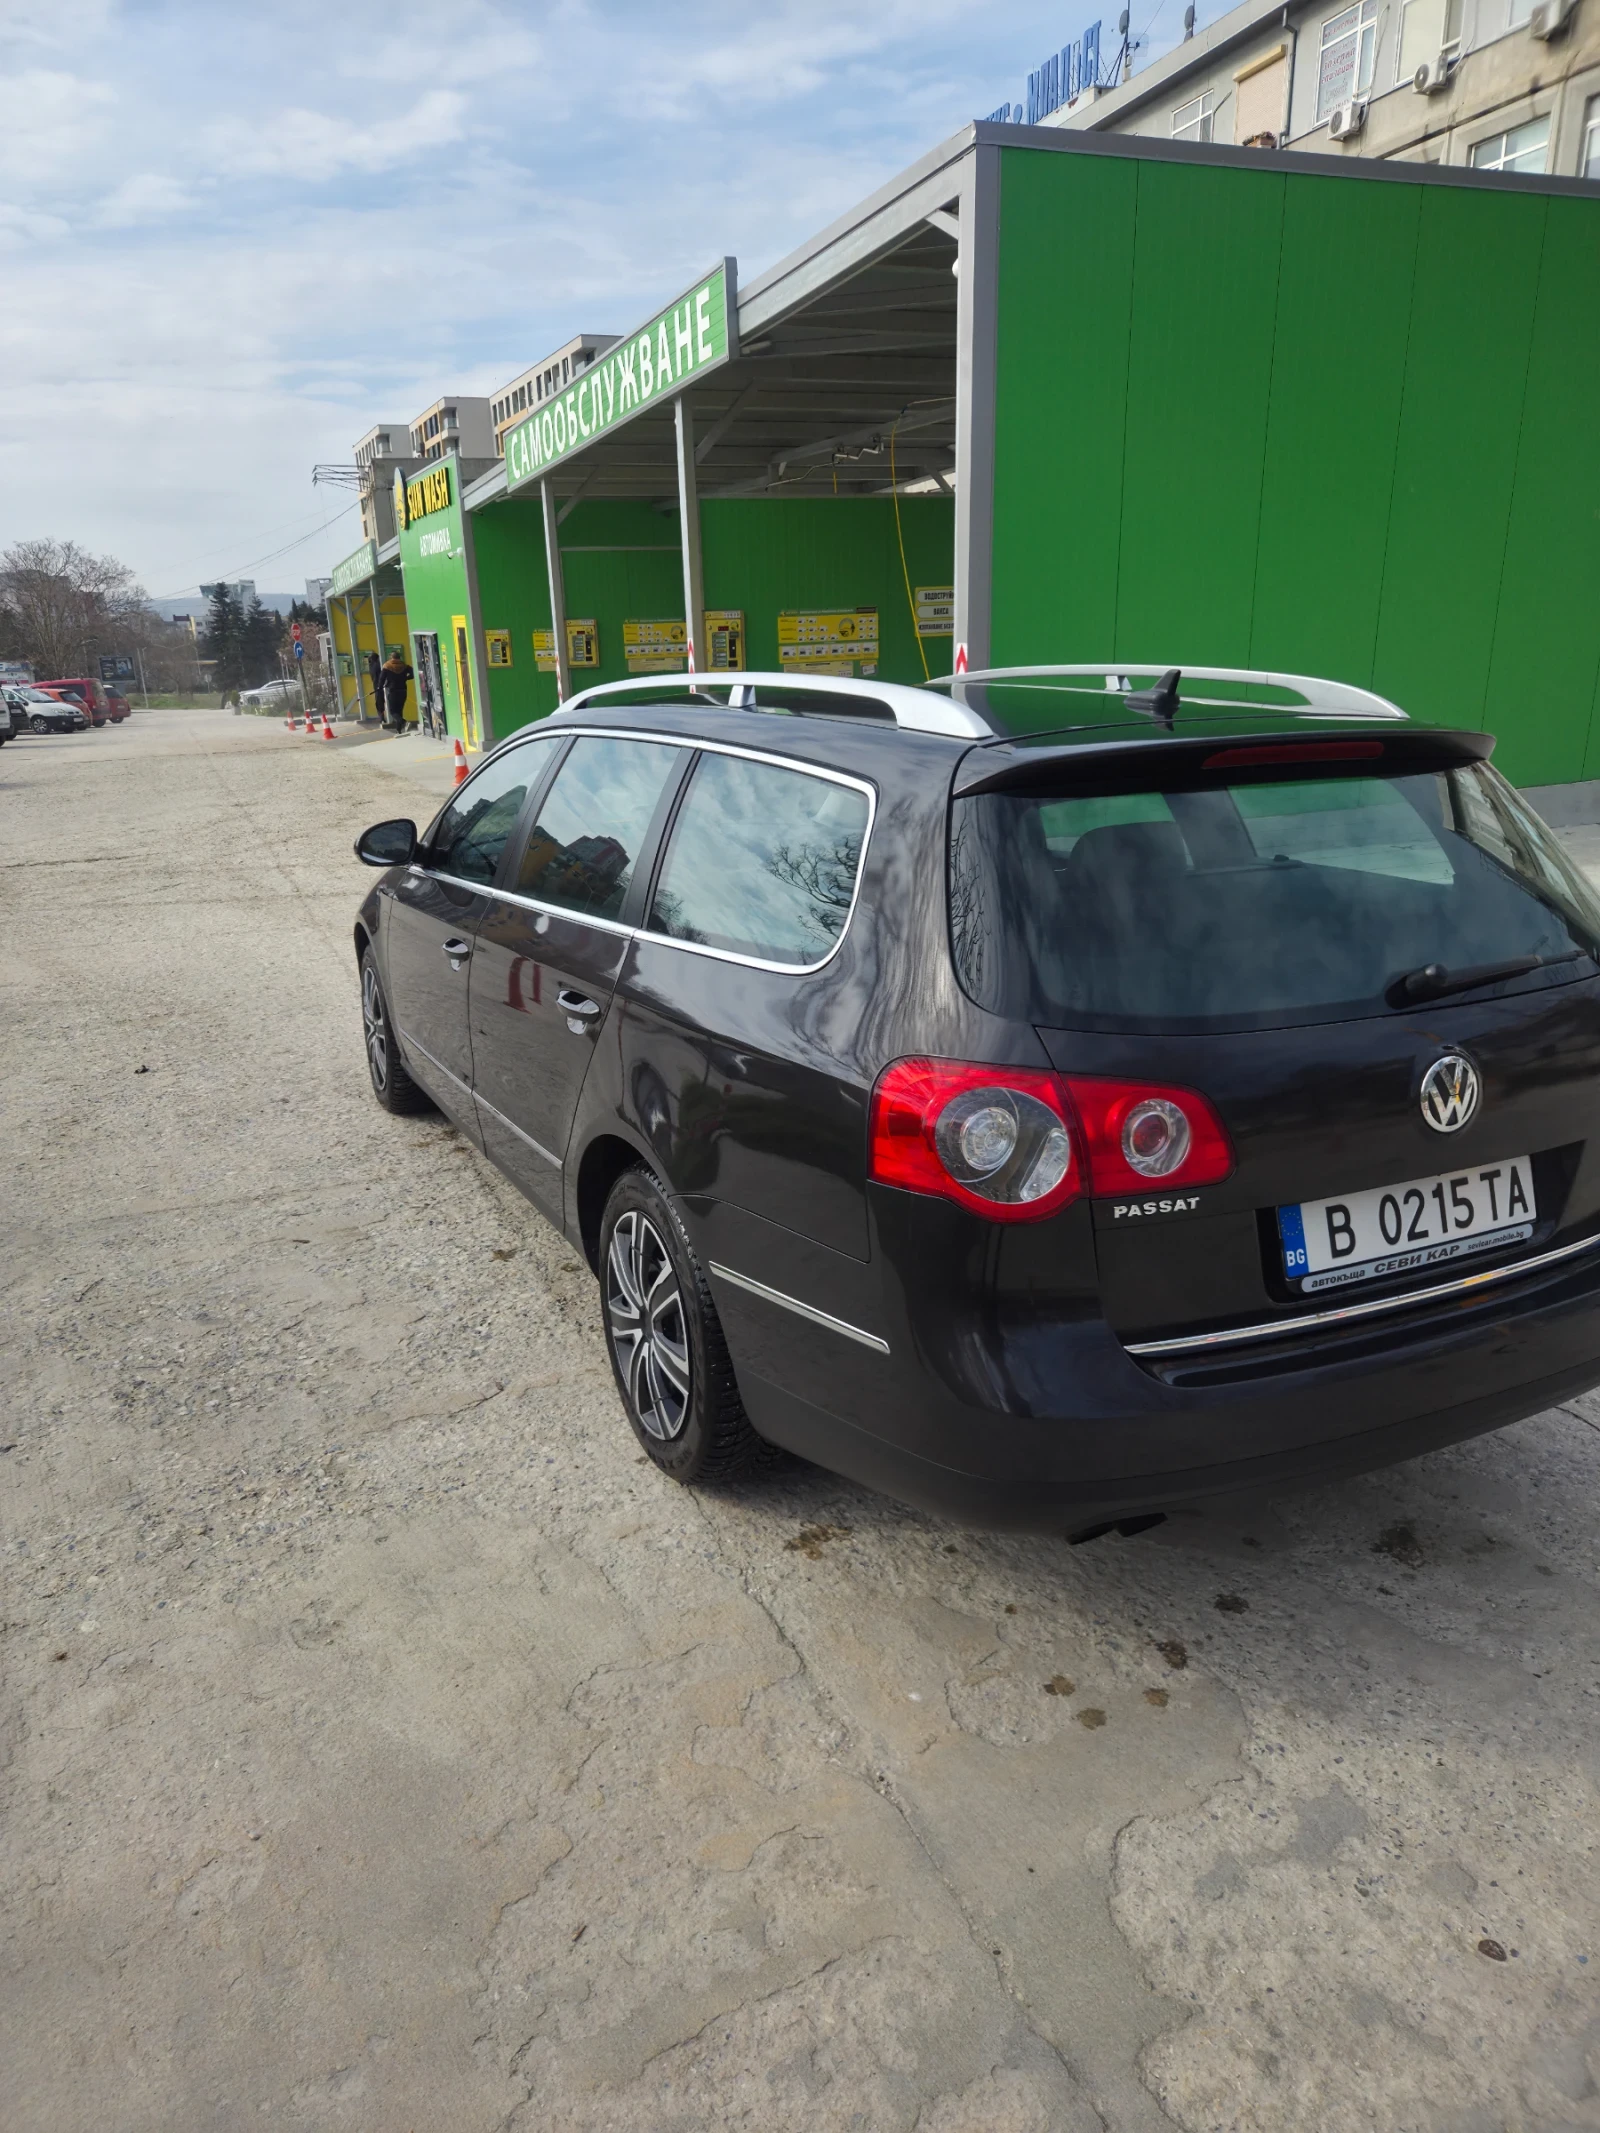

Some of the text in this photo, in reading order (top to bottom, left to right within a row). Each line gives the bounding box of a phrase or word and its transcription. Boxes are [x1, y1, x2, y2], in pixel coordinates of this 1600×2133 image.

[511, 286, 713, 479] САМООБСЛУЖВАНЕ
[407, 467, 450, 521] SUN WASH
[1113, 1196, 1200, 1219] PASSAT
[1325, 1165, 1530, 1260] B 0215 TA
[1286, 1250, 1306, 1267] BG
[1310, 1230, 1525, 1289] автокъща СЕВИ КАР sevicar.mobile.bg
